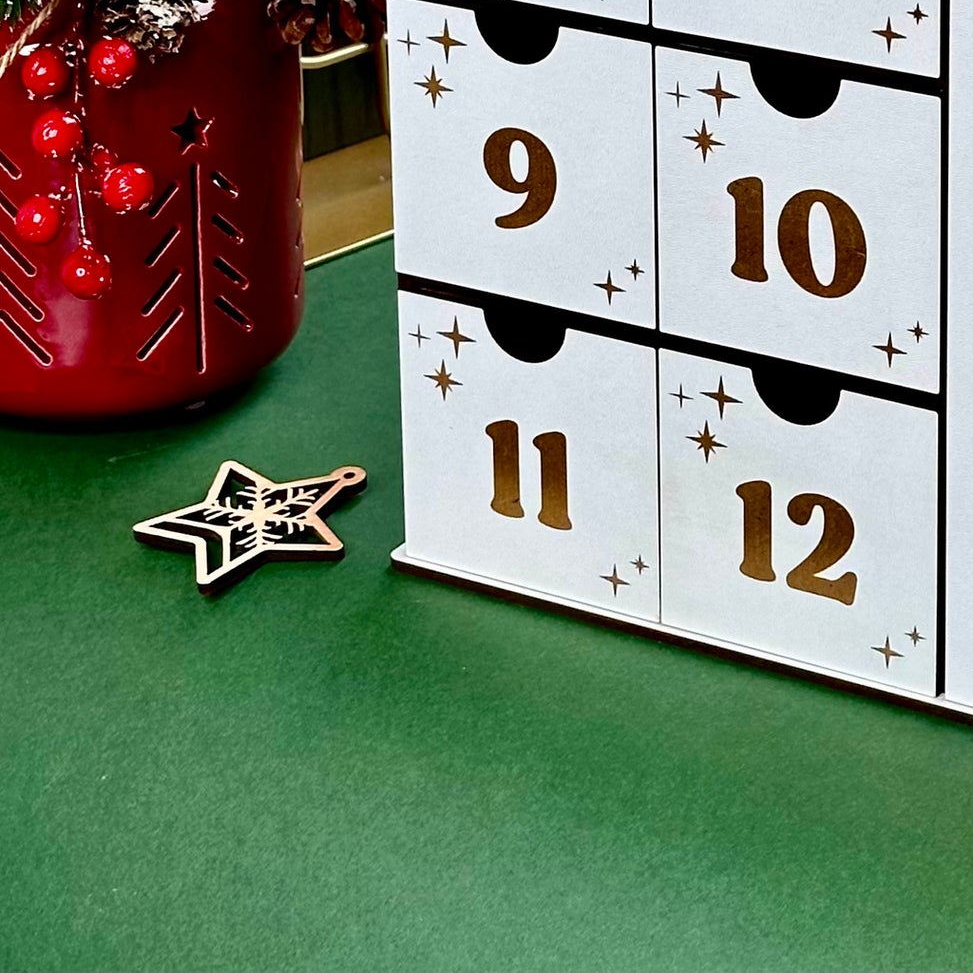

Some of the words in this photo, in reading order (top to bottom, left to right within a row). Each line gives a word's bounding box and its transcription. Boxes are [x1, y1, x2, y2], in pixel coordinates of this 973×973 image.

[483, 128, 557, 229] 9
[727, 177, 867, 298] 10
[485, 420, 572, 530] 11
[736, 480, 857, 605] 12
